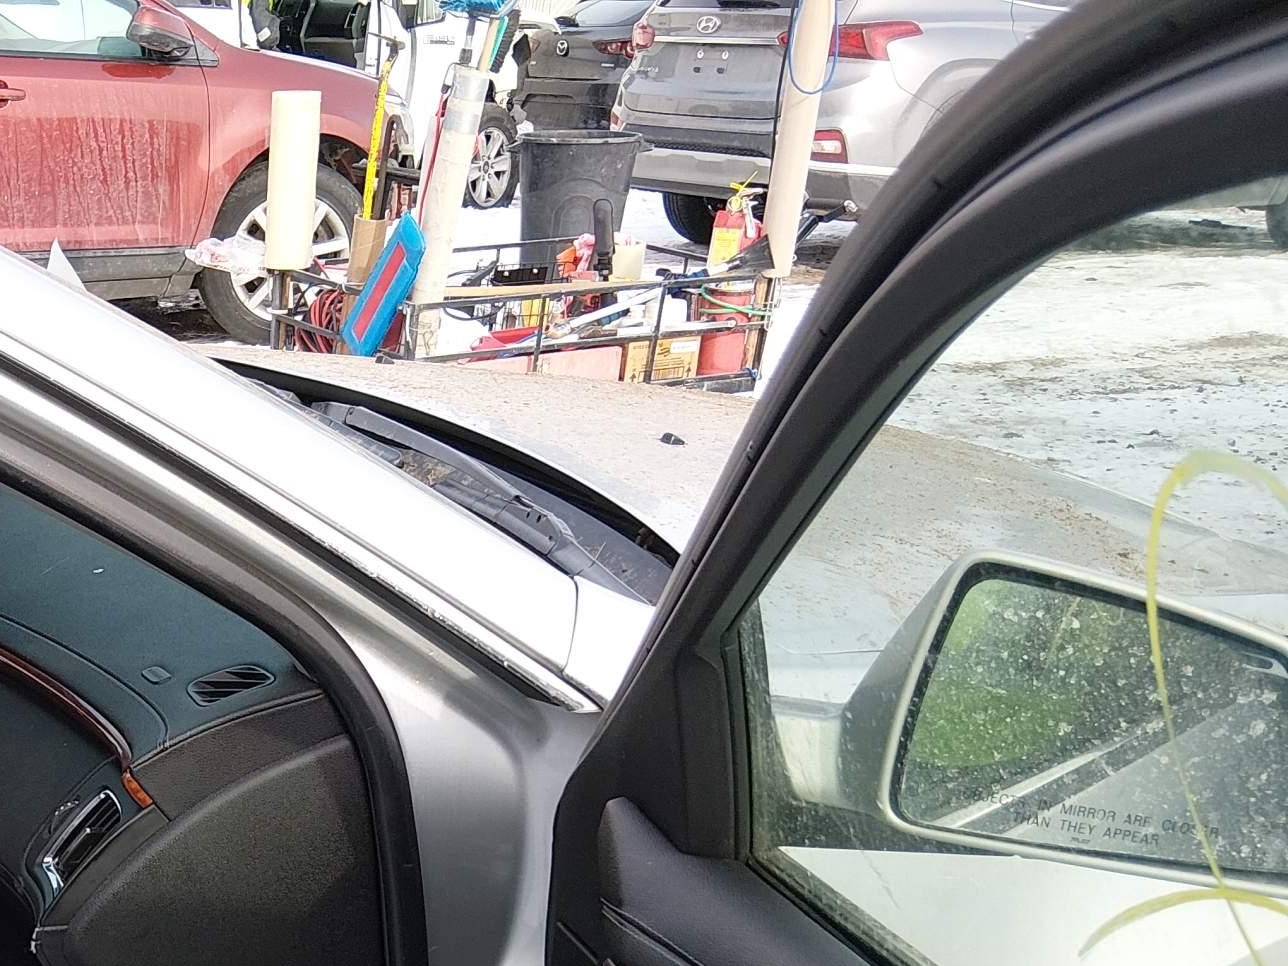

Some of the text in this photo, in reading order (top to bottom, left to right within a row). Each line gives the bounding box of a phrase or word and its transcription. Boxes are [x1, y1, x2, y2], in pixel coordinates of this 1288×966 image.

[1038, 798, 1051, 812] IN
[1060, 802, 1116, 822] MIRROR
[1013, 811, 1050, 828] THAN
[1060, 819, 1096, 834] THEY
[1103, 827, 1160, 846] APPEAR
